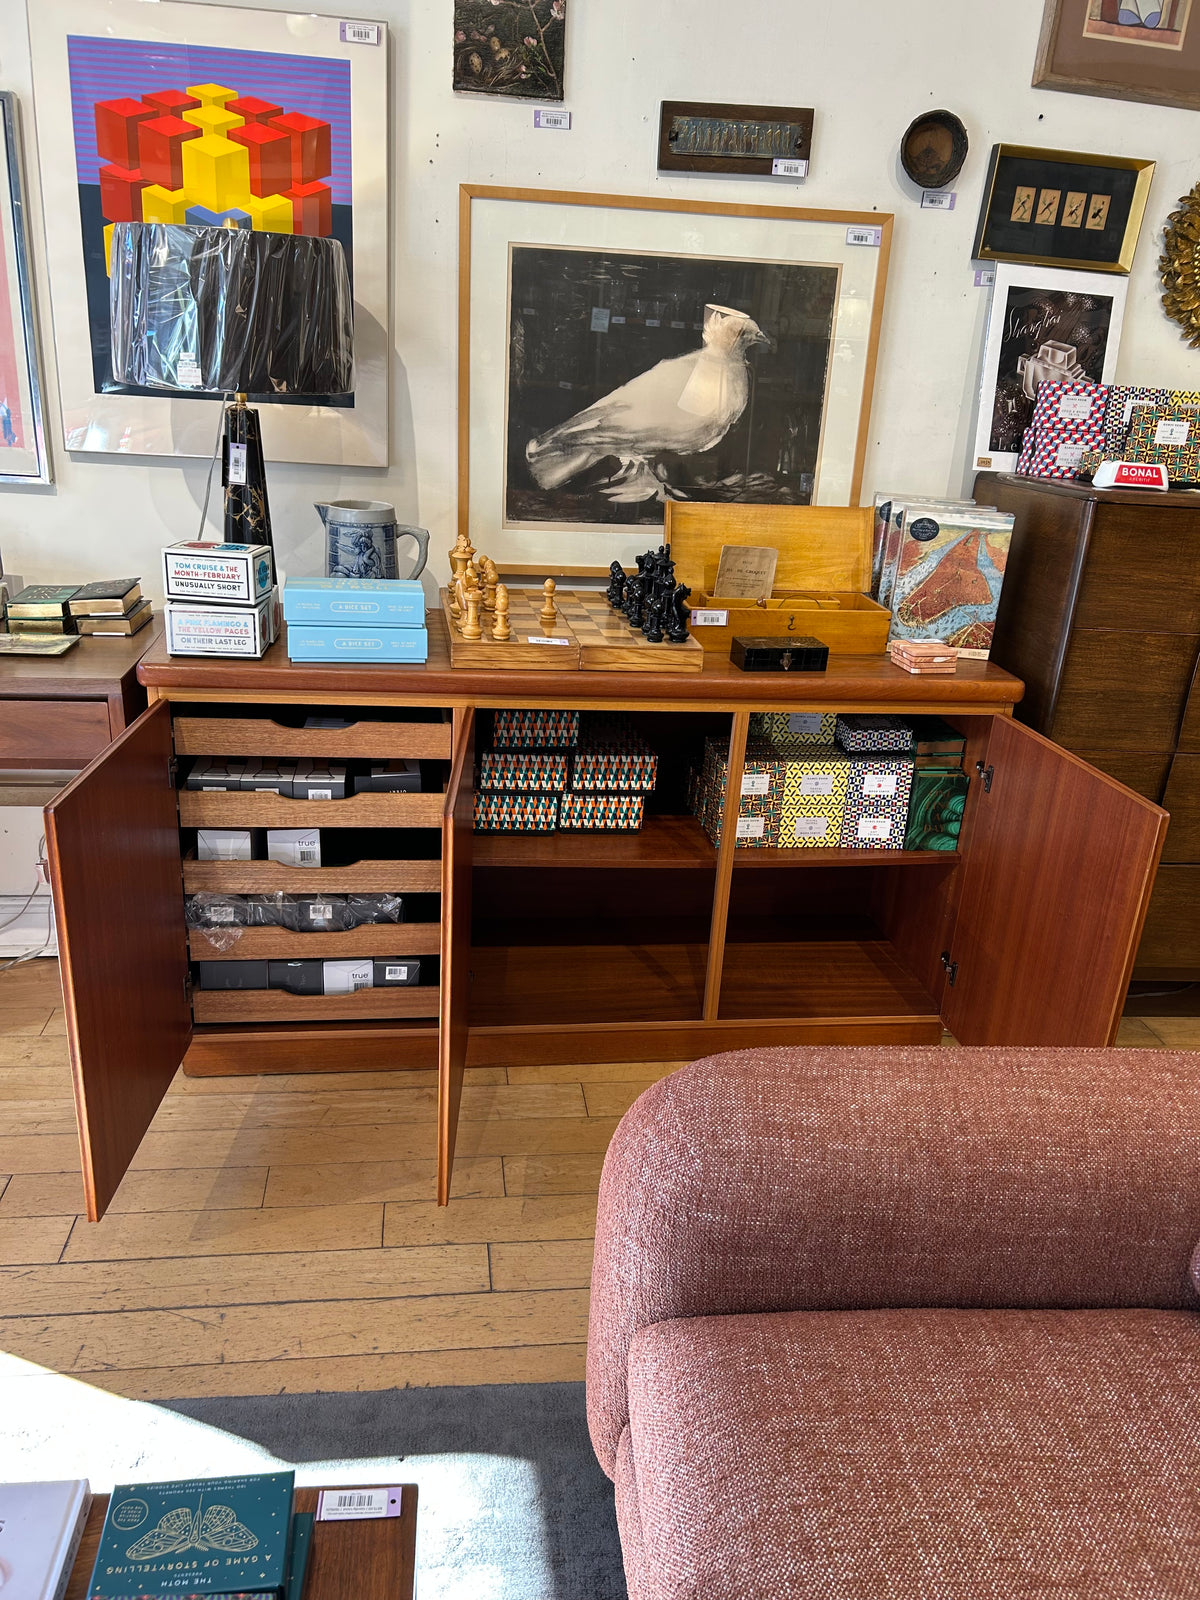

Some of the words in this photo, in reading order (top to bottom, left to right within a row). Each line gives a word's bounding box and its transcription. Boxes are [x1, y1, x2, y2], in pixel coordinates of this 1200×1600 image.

[1004, 304, 1063, 342] Shanghai
[1122, 467, 1158, 478] BONAL
[174, 570, 241, 580] MONTH-FEBRUARY
[175, 581, 215, 590] UNUSUALLY
[204, 1559, 219, 1567] OF
[226, 1555, 258, 1565] GAME
[106, 1560, 198, 1574] STORYTELLING
